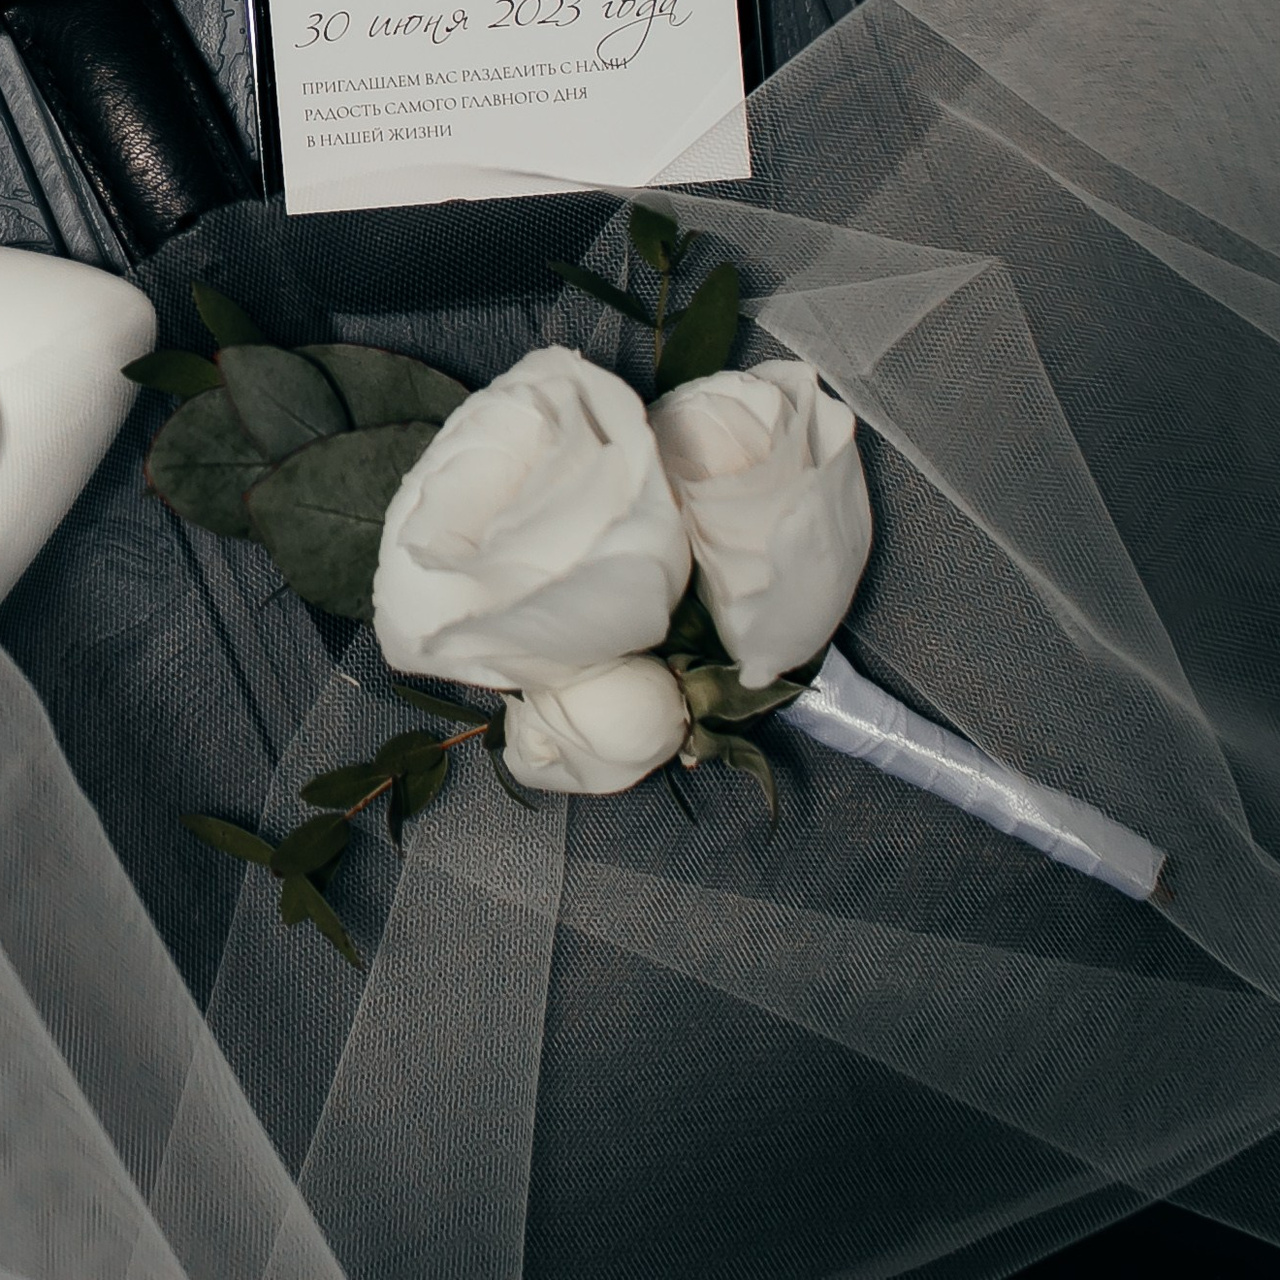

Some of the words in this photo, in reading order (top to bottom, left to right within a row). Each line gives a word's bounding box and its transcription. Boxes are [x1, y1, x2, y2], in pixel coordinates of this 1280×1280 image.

[294, 11, 350, 49] 30
[368, 8, 469, 45] июня
[302, 73, 421, 96] ПРИГЛАШАЕМ
[425, 70, 458, 86] ВАС
[461, 63, 557, 83] РАЗДЕЛИТЬ
[559, 61, 572, 75] С
[304, 103, 382, 122] РАДОСТЬ
[384, 97, 457, 115] САМОГО
[461, 89, 550, 109] ГЛАВНОГО
[553, 86, 588, 104] ДНЯ
[306, 135, 316, 148] В
[320, 126, 384, 147] НАШЕЙ
[388, 124, 452, 142] ЖИЗНИ
